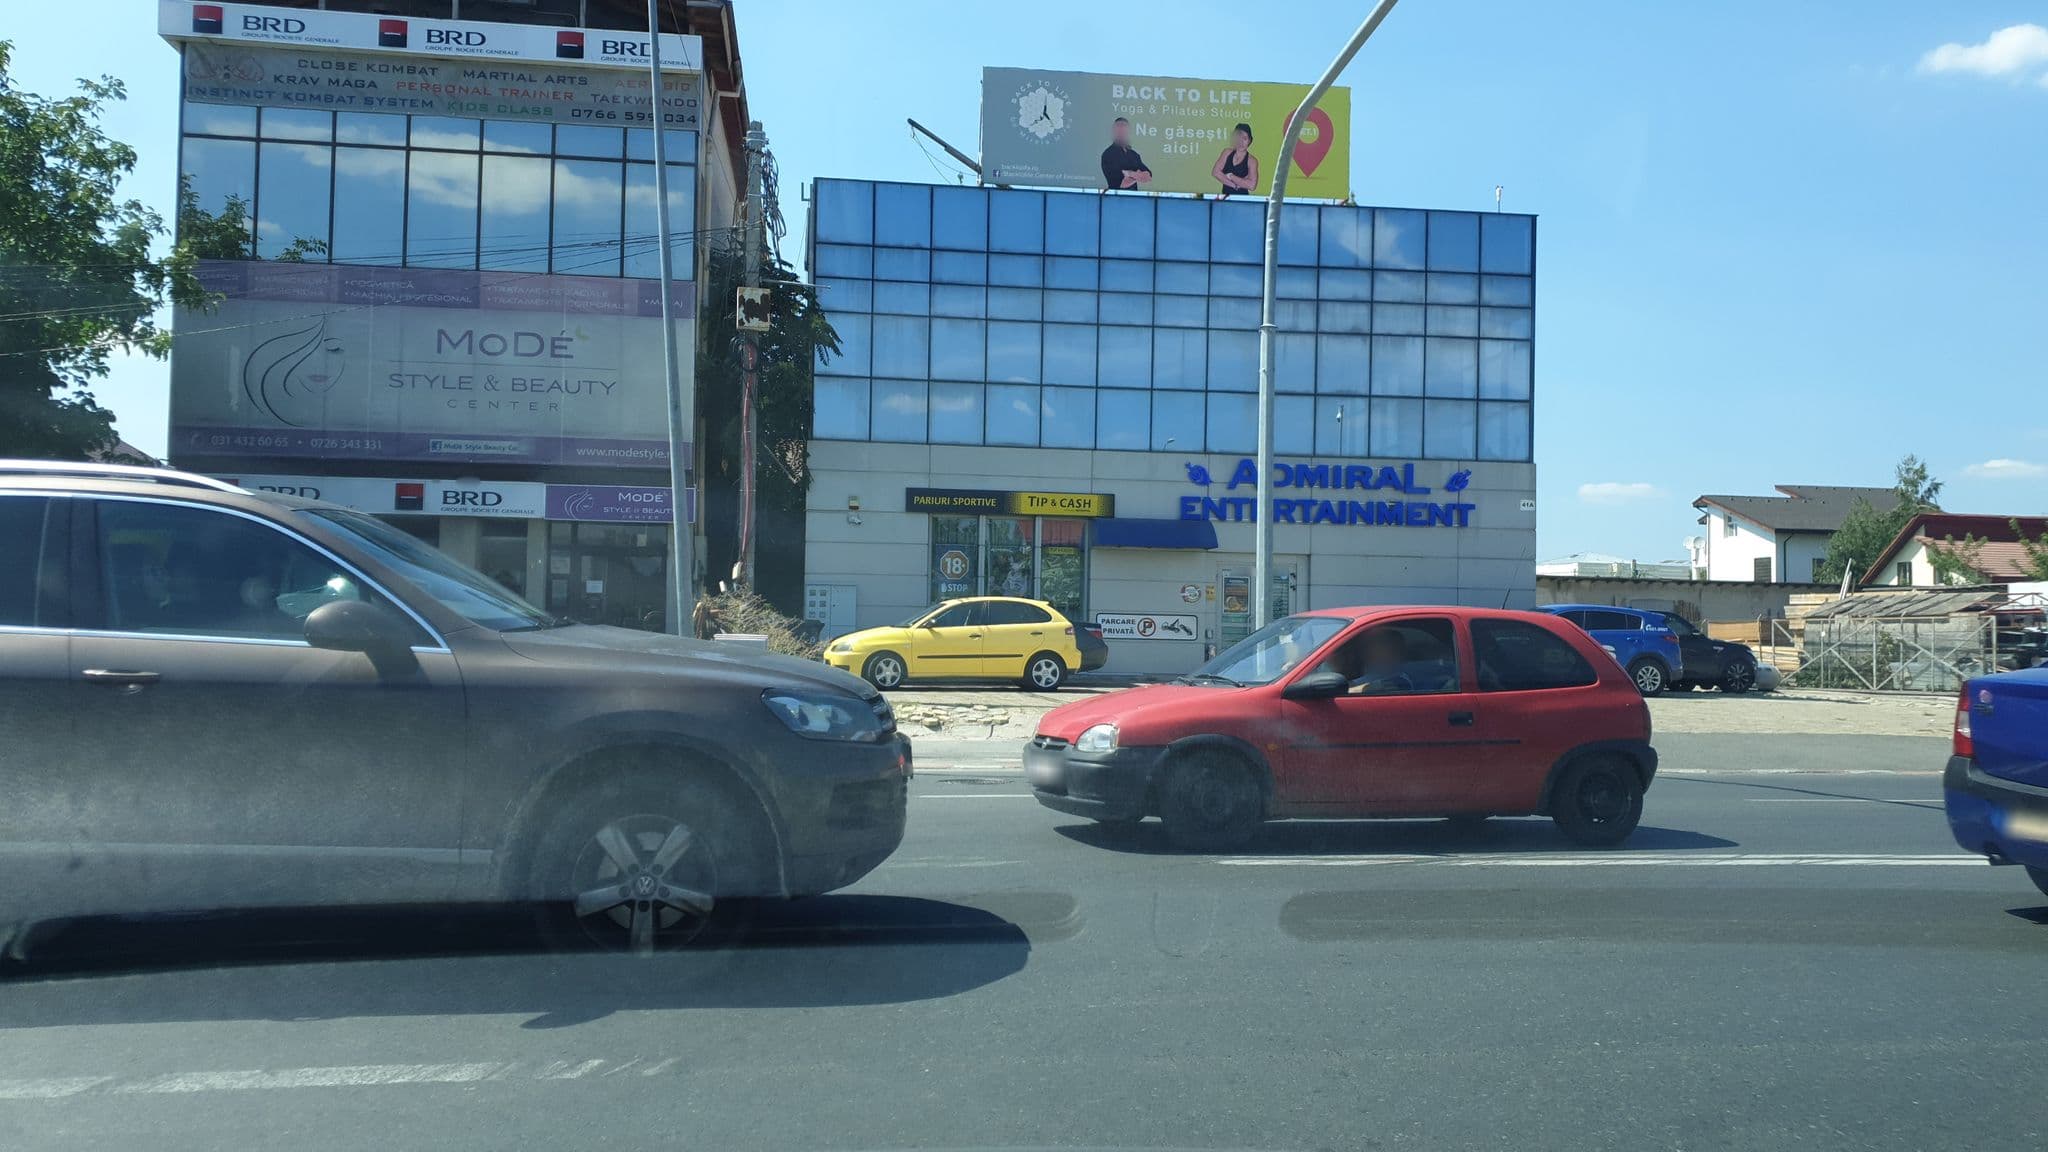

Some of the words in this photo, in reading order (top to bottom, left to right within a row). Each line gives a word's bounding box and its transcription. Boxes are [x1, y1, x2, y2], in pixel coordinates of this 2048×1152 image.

[242, 15, 306, 34] BRD
[427, 29, 486, 46] BRD
[298, 59, 358, 72] CLOSE
[366, 63, 439, 77] KOMBAT
[463, 69, 538, 83] MARTIAL
[544, 74, 588, 86] ARTS
[616, 80, 691, 92] AERBIC
[274, 74, 320, 86] KRAV
[328, 76, 379, 89] MAGA
[396, 81, 492, 96] PERSONAL
[498, 88, 575, 102] TRAINER
[1112, 84, 1166, 102] BACK
[1176, 88, 1201, 103] TO
[1209, 89, 1252, 104] LIFE
[188, 85, 280, 100] INSTINCT
[283, 92, 358, 106] KOMBAT
[364, 96, 434, 109] SYSTEM
[447, 102, 490, 114] KIDS
[496, 104, 554, 116] CLASS
[572, 108, 616, 120] 0766
[664, 114, 697, 124] 034
[1112, 103, 1144, 115] Yoga
[1149, 105, 1157, 114] &
[1162, 104, 1206, 117] Pilates
[1210, 108, 1252, 119] Studio
[1136, 123, 1158, 137] Ne
[1163, 142, 1200, 154] aici!
[650, 298, 683, 308] MAJ
[388, 373, 473, 390] STYLE
[483, 374, 500, 392] &
[512, 378, 616, 396] BEAUTY
[446, 399, 560, 412] CENTER
[310, 438, 338, 450] 0726
[363, 439, 382, 450] 331
[1228, 458, 1432, 494] ADMIRAL
[442, 490, 503, 508] BRD
[913, 496, 950, 505] PARIURI
[952, 497, 998, 507] SPORTIVE
[1028, 496, 1048, 508] TIP
[1060, 498, 1092, 509] CASH
[1180, 496, 1477, 528] ENTRTAINMENT
[948, 584, 968, 592] STOP
[1102, 626, 1135, 636] PRIVATĂ
